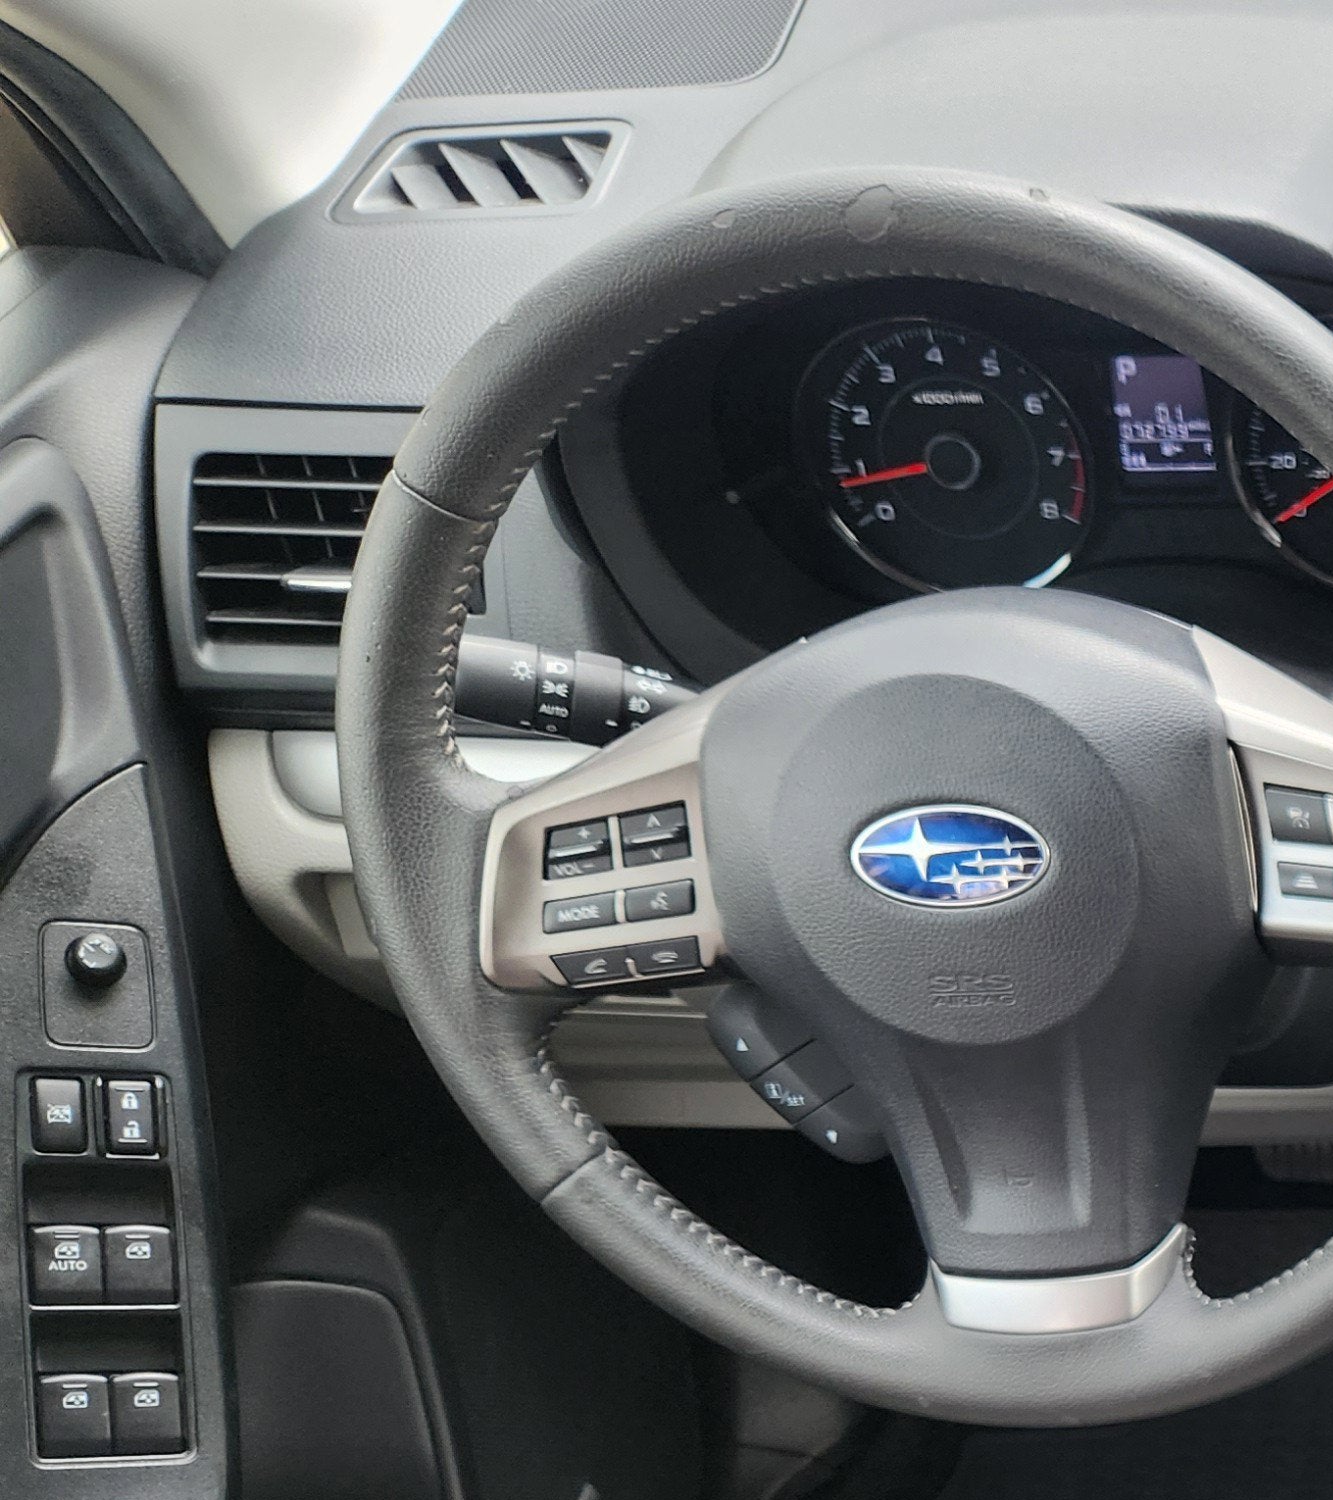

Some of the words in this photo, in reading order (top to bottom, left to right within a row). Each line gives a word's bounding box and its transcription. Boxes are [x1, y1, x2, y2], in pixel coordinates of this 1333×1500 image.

[925, 346, 944, 366] 4
[980, 356, 1000, 376] 5
[878, 364, 896, 384] 3
[1115, 355, 1137, 385] P
[1024, 394, 1044, 415] 6
[852, 405, 871, 425] 2
[1270, 452, 1296, 469] 20
[874, 502, 896, 521] 0
[1039, 499, 1060, 519] 8
[538, 704, 569, 718] AUTO
[553, 862, 583, 877] VOL
[558, 905, 600, 921] MODE
[48, 1260, 87, 1271] AUTO
